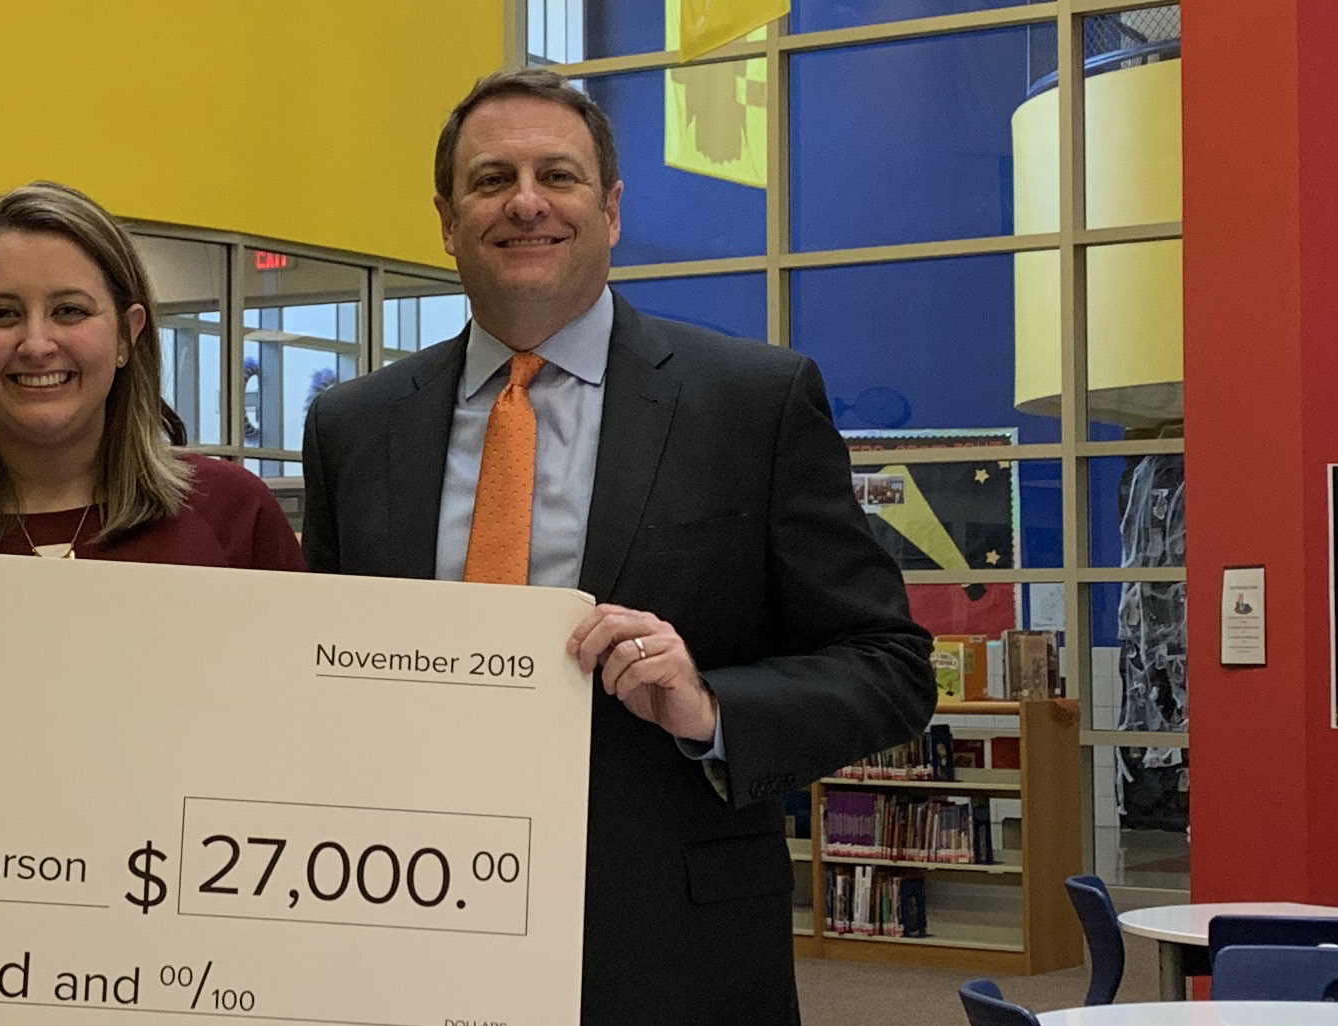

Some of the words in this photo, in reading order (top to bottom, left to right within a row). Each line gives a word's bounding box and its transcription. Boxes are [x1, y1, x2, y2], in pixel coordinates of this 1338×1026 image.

[316, 643, 460, 673] November
[469, 653, 535, 678] 2019
[124, 840, 168, 914] $
[54, 967, 140, 1004] and
